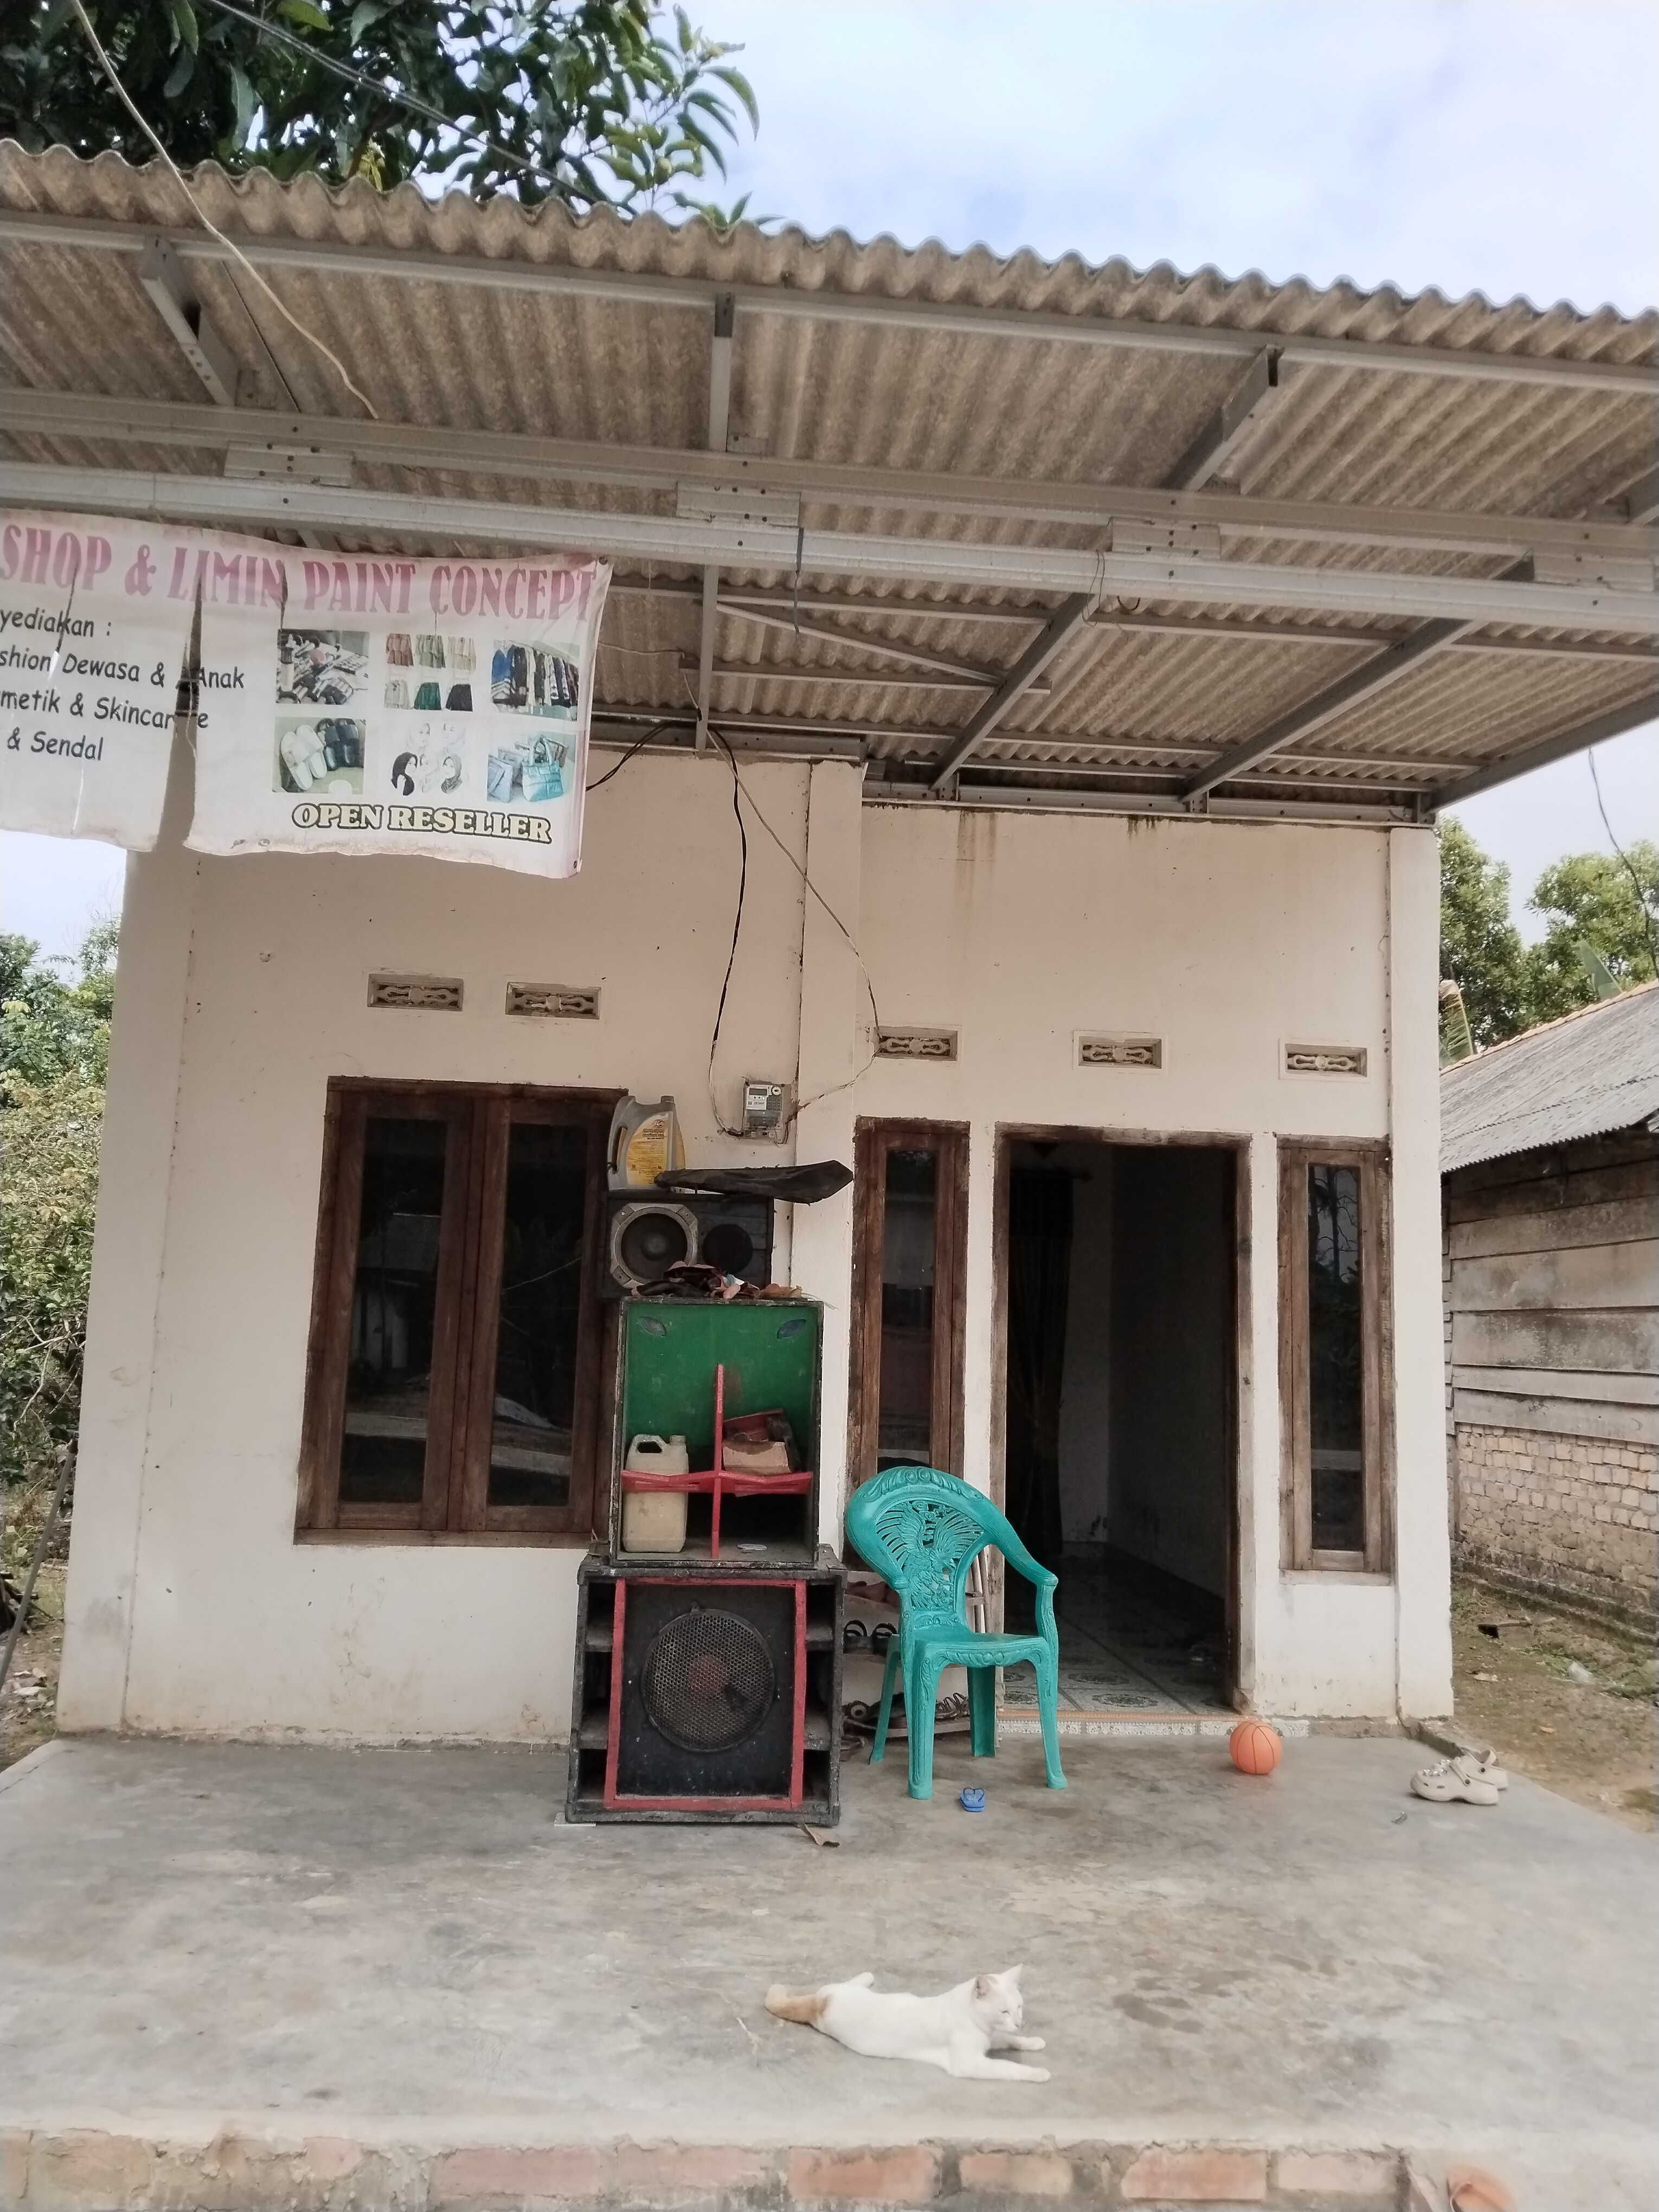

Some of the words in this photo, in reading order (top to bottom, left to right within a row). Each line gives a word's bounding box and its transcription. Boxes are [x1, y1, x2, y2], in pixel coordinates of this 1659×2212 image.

[0, 524, 112, 590] SHOP
[125, 544, 156, 596] &
[167, 546, 288, 609] LIMIN
[303, 561, 416, 614] PAINT
[429, 565, 596, 621] CONCEPT
[0, 644, 51, 672] shion
[62, 653, 140, 682] Dewasa
[150, 661, 165, 688] &
[0, 689, 60, 713] metik
[70, 692, 83, 717] &
[7, 726, 21, 751] &
[30, 731, 104, 761] Sendal
[292, 802, 384, 830] OPEN
[387, 804, 552, 844] RESELLER
